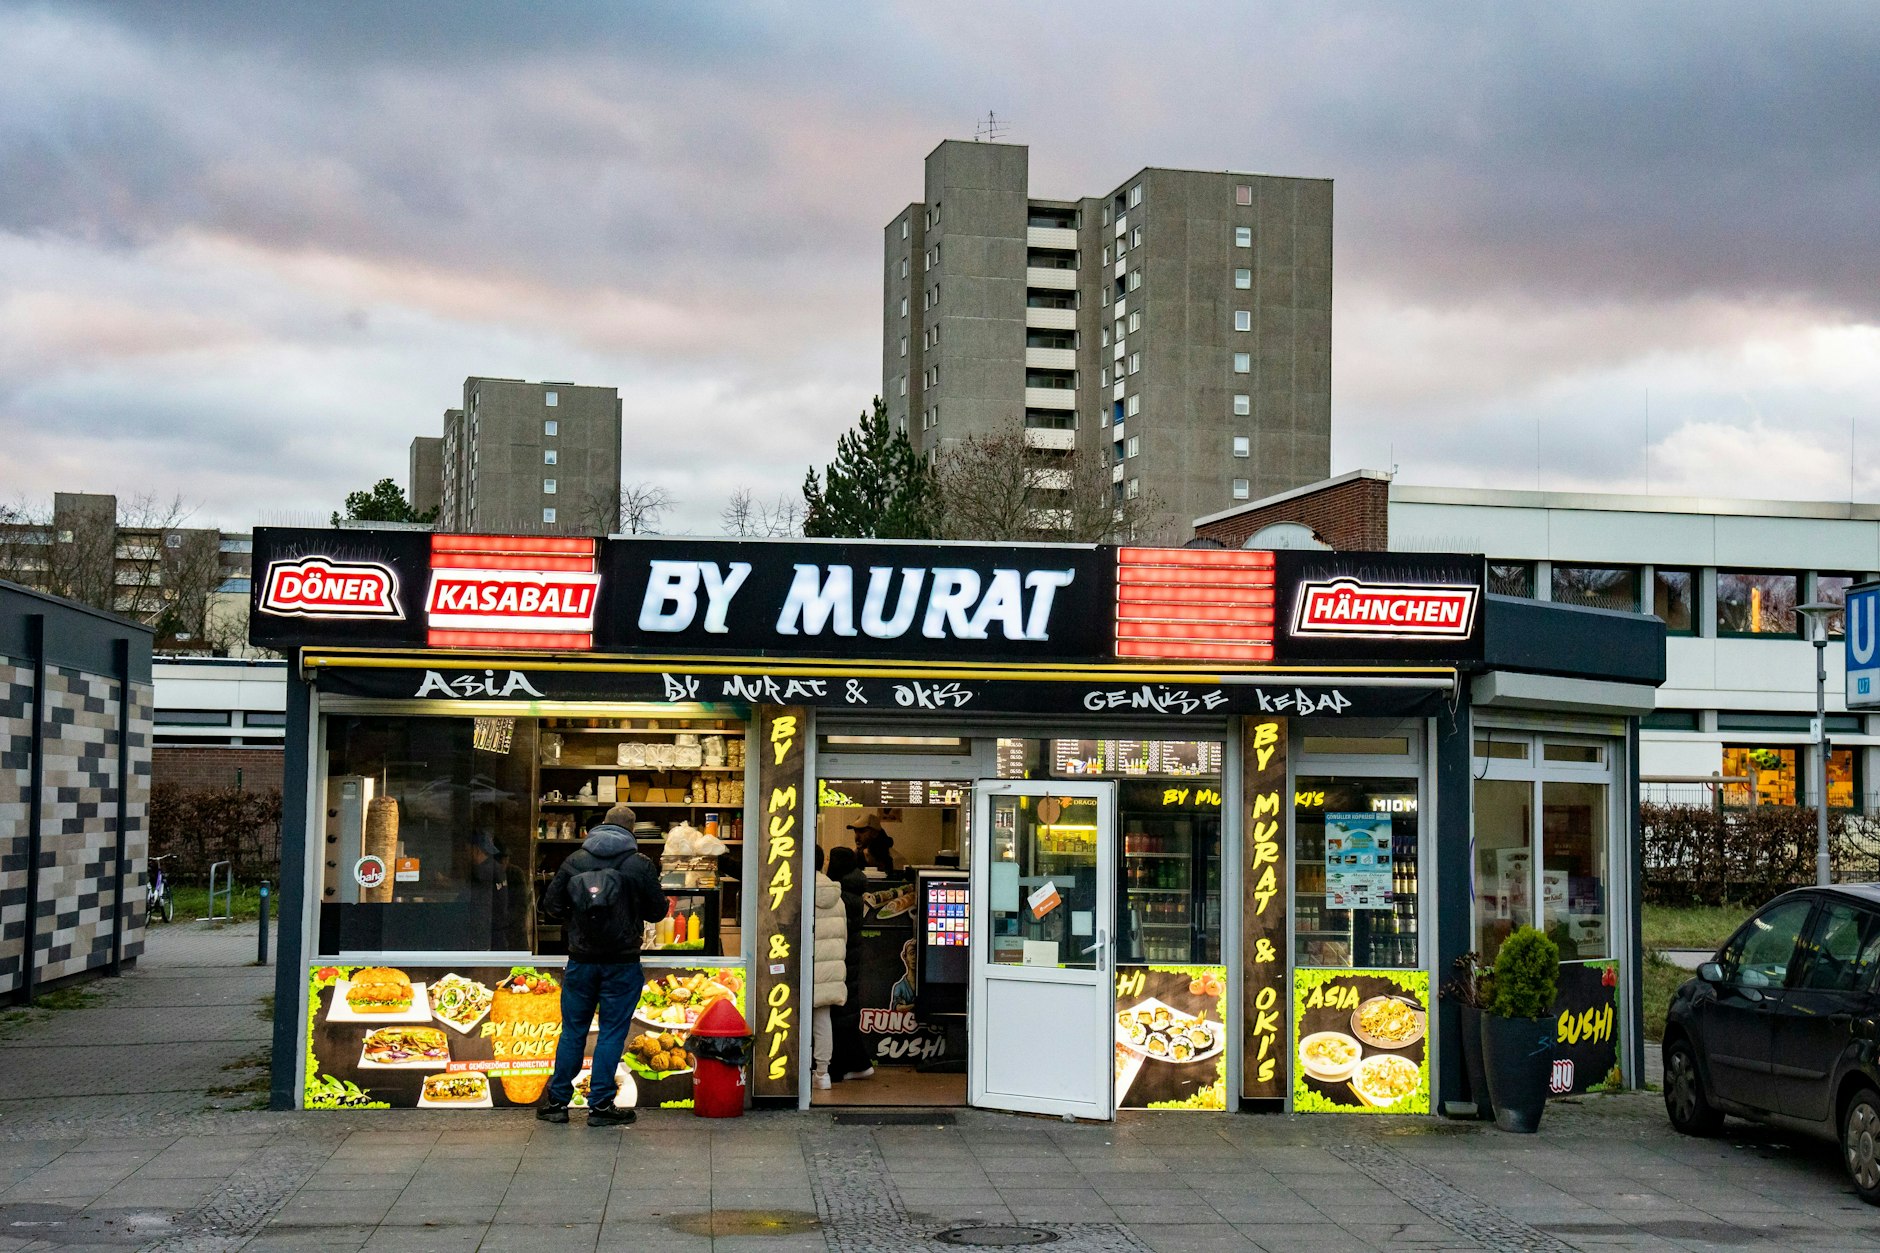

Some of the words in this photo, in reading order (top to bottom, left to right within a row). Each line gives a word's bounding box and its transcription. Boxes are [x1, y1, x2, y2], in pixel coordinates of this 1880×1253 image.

[280, 573, 379, 601] DÖNER
[437, 585, 590, 613] KASABALI
[638, 560, 752, 634] BY
[775, 563, 1075, 641] MURAT
[1314, 593, 1460, 623] HÄHNCHEN
[1851, 595, 1876, 665] U
[661, 672, 700, 703] BY
[722, 675, 827, 706] MURAT
[845, 678, 868, 705] &
[1858, 679, 1869, 692] U7
[1162, 788, 1189, 806] BY
[769, 934, 790, 960] &
[1255, 938, 1277, 964] &
[1115, 969, 1146, 998] HI
[1305, 984, 1360, 1011] ASIA
[480, 1020, 506, 1039] BY
[1556, 1001, 1613, 1046] SUSHI
[493, 1040, 506, 1056] &
[876, 1034, 946, 1060] SUSHI
[512, 1060, 549, 1069] CONNECTION
[1550, 1059, 1574, 1093] HU
